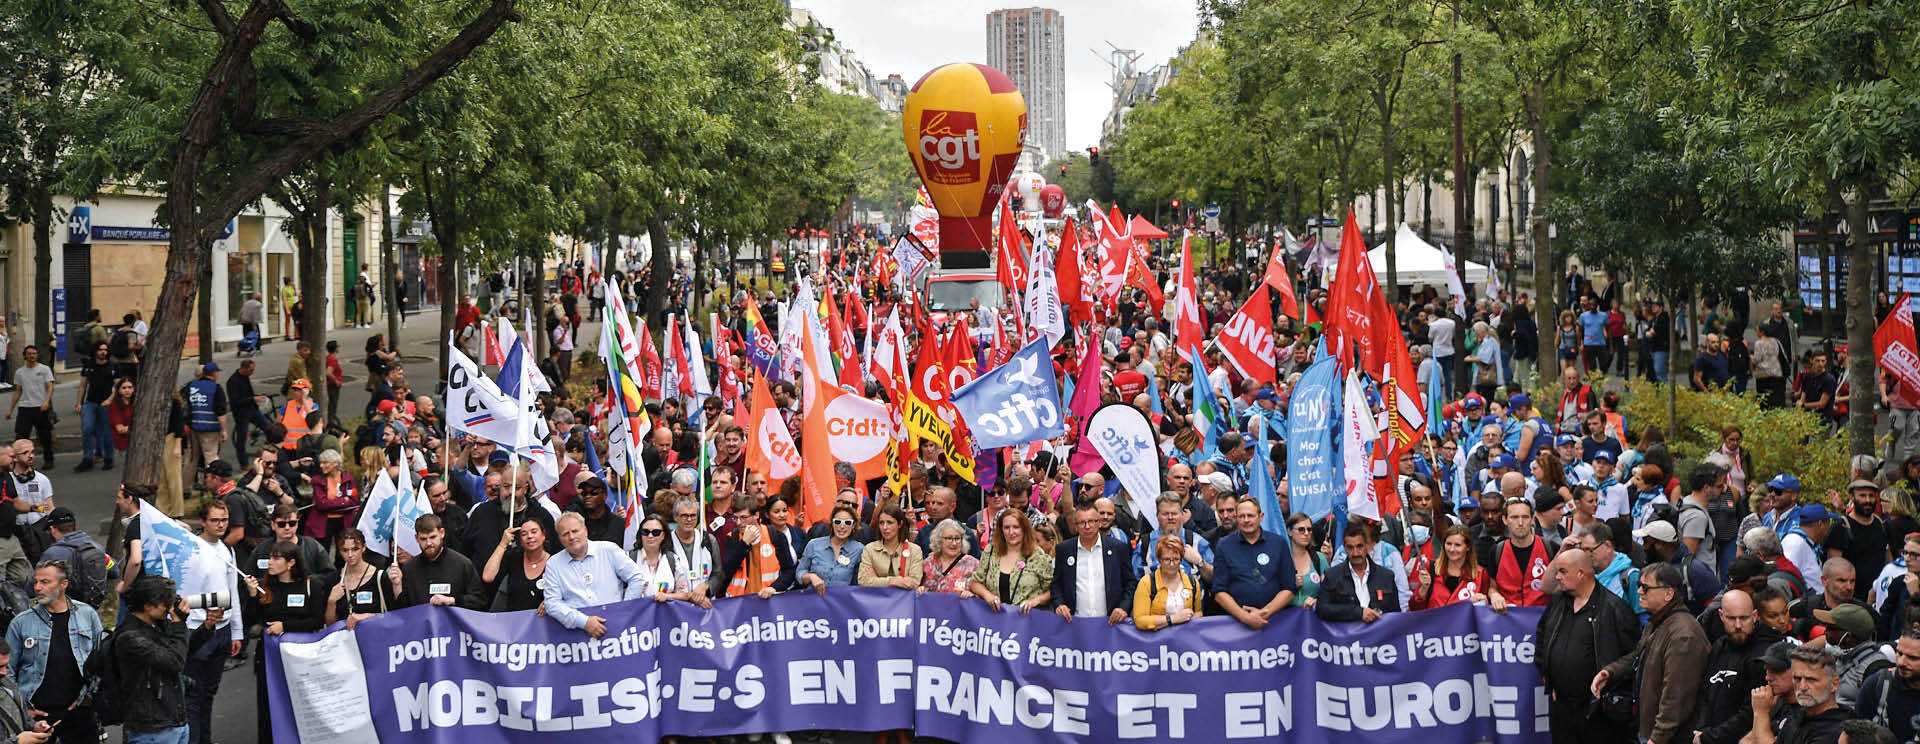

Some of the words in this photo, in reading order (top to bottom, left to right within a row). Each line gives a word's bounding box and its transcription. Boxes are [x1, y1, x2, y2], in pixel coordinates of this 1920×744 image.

[920, 128, 980, 169] cgt
[921, 112, 952, 136] la
[389, 635, 451, 672] pour
[460, 627, 661, 672] l'augmentation
[670, 622, 714, 650] des
[721, 615, 839, 648] salaires,
[848, 616, 912, 644] pour
[919, 617, 1020, 661] l'égalité
[1028, 637, 1294, 673] femmes-hommes,
[1302, 637, 1397, 667] contre
[1406, 632, 1536, 664] l'ausrité
[787, 660, 857, 705] EN
[877, 659, 1090, 736] FRANCE
[1117, 693, 1197, 739] ET
[1225, 684, 1293, 739] EN
